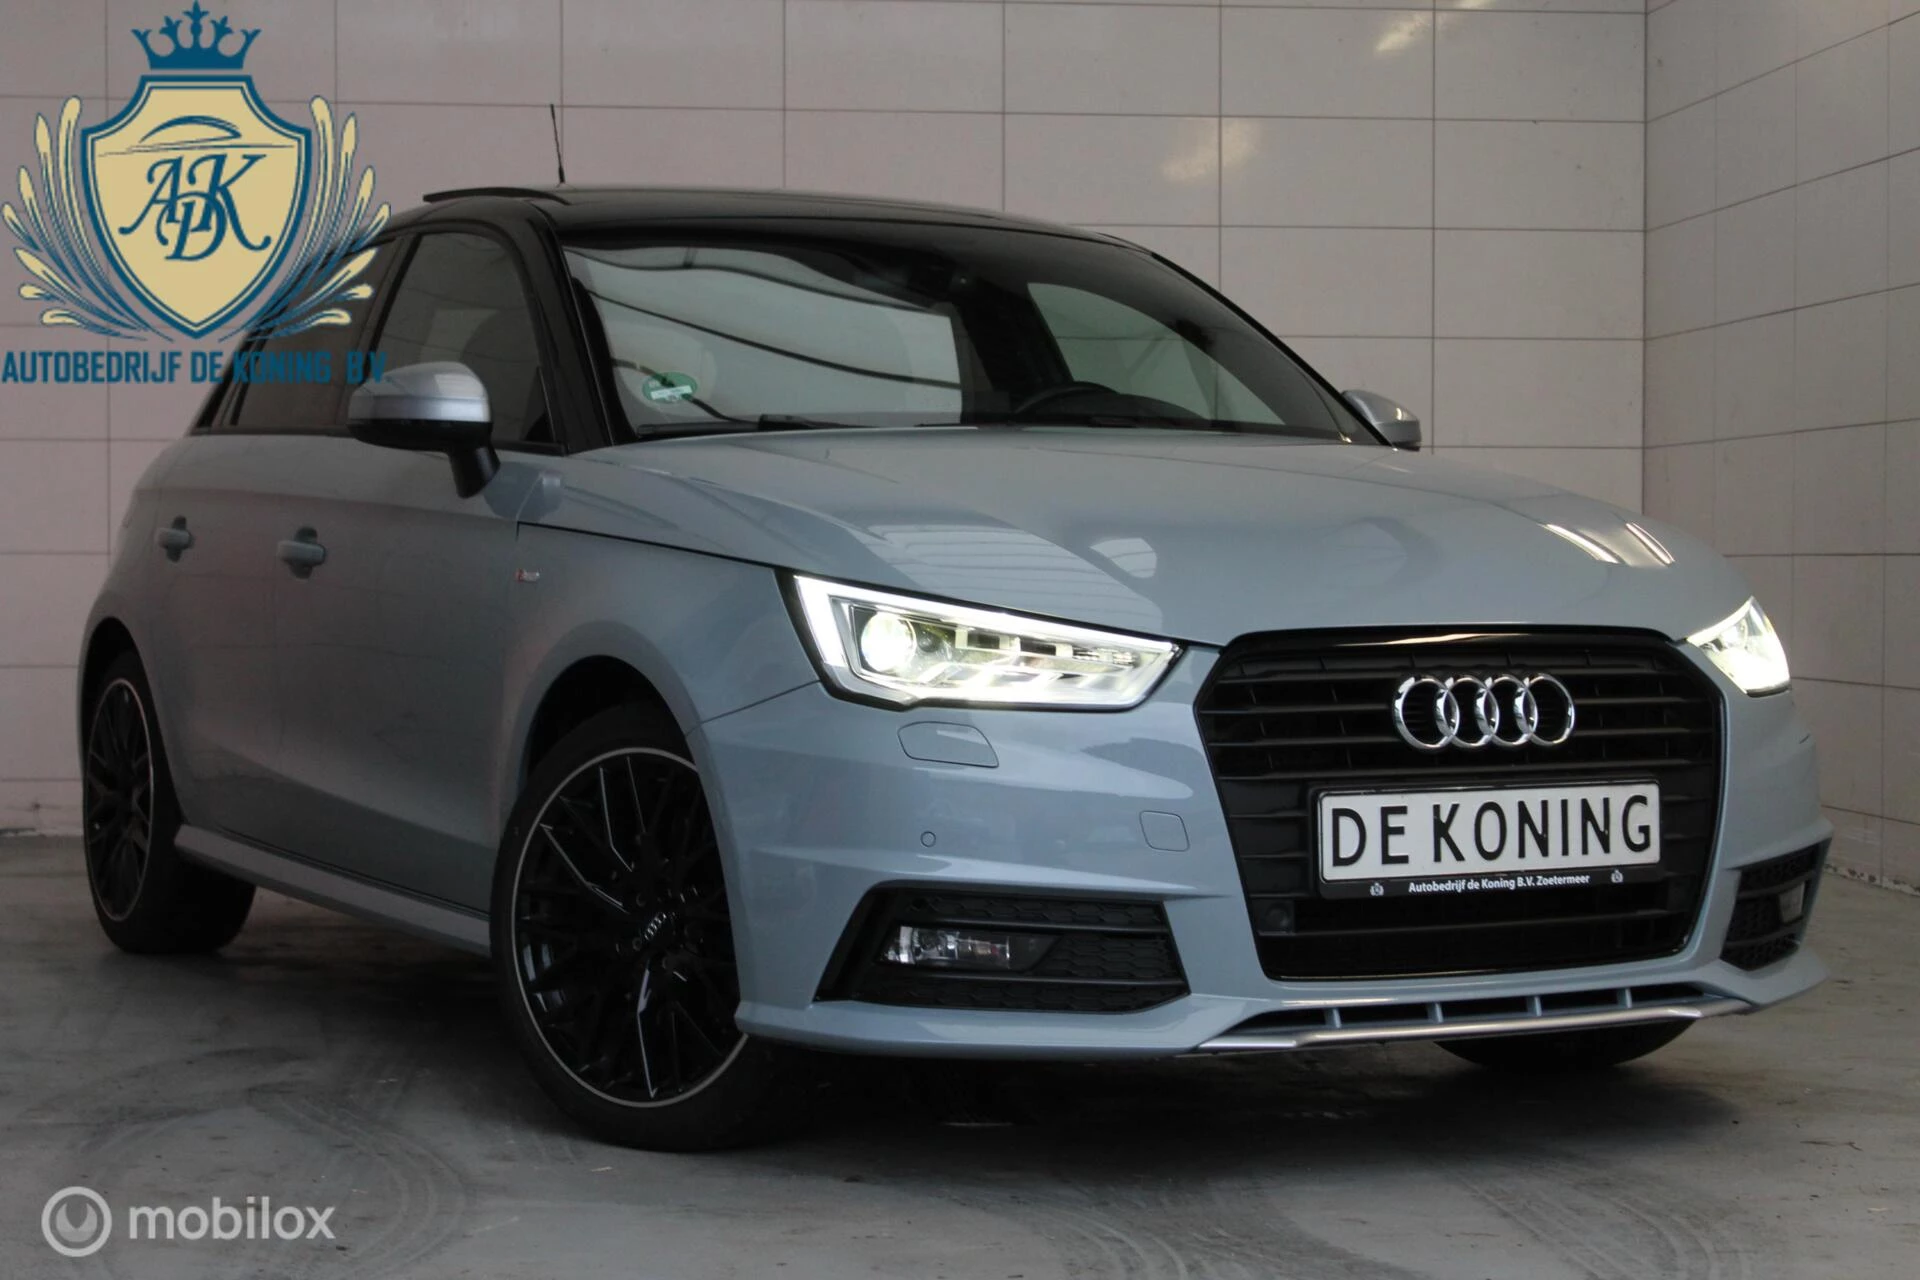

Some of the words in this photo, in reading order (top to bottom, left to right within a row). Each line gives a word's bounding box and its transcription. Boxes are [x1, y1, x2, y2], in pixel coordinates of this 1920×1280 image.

[1332, 805, 1410, 867] DE
[1433, 795, 1652, 863] KONING
[1408, 880, 1465, 893] Autobedrijf
[1467, 878, 1480, 890] de
[1481, 877, 1516, 891] Koning
[1517, 876, 1535, 887] B.V.
[1536, 875, 1590, 886] Zoetermeer
